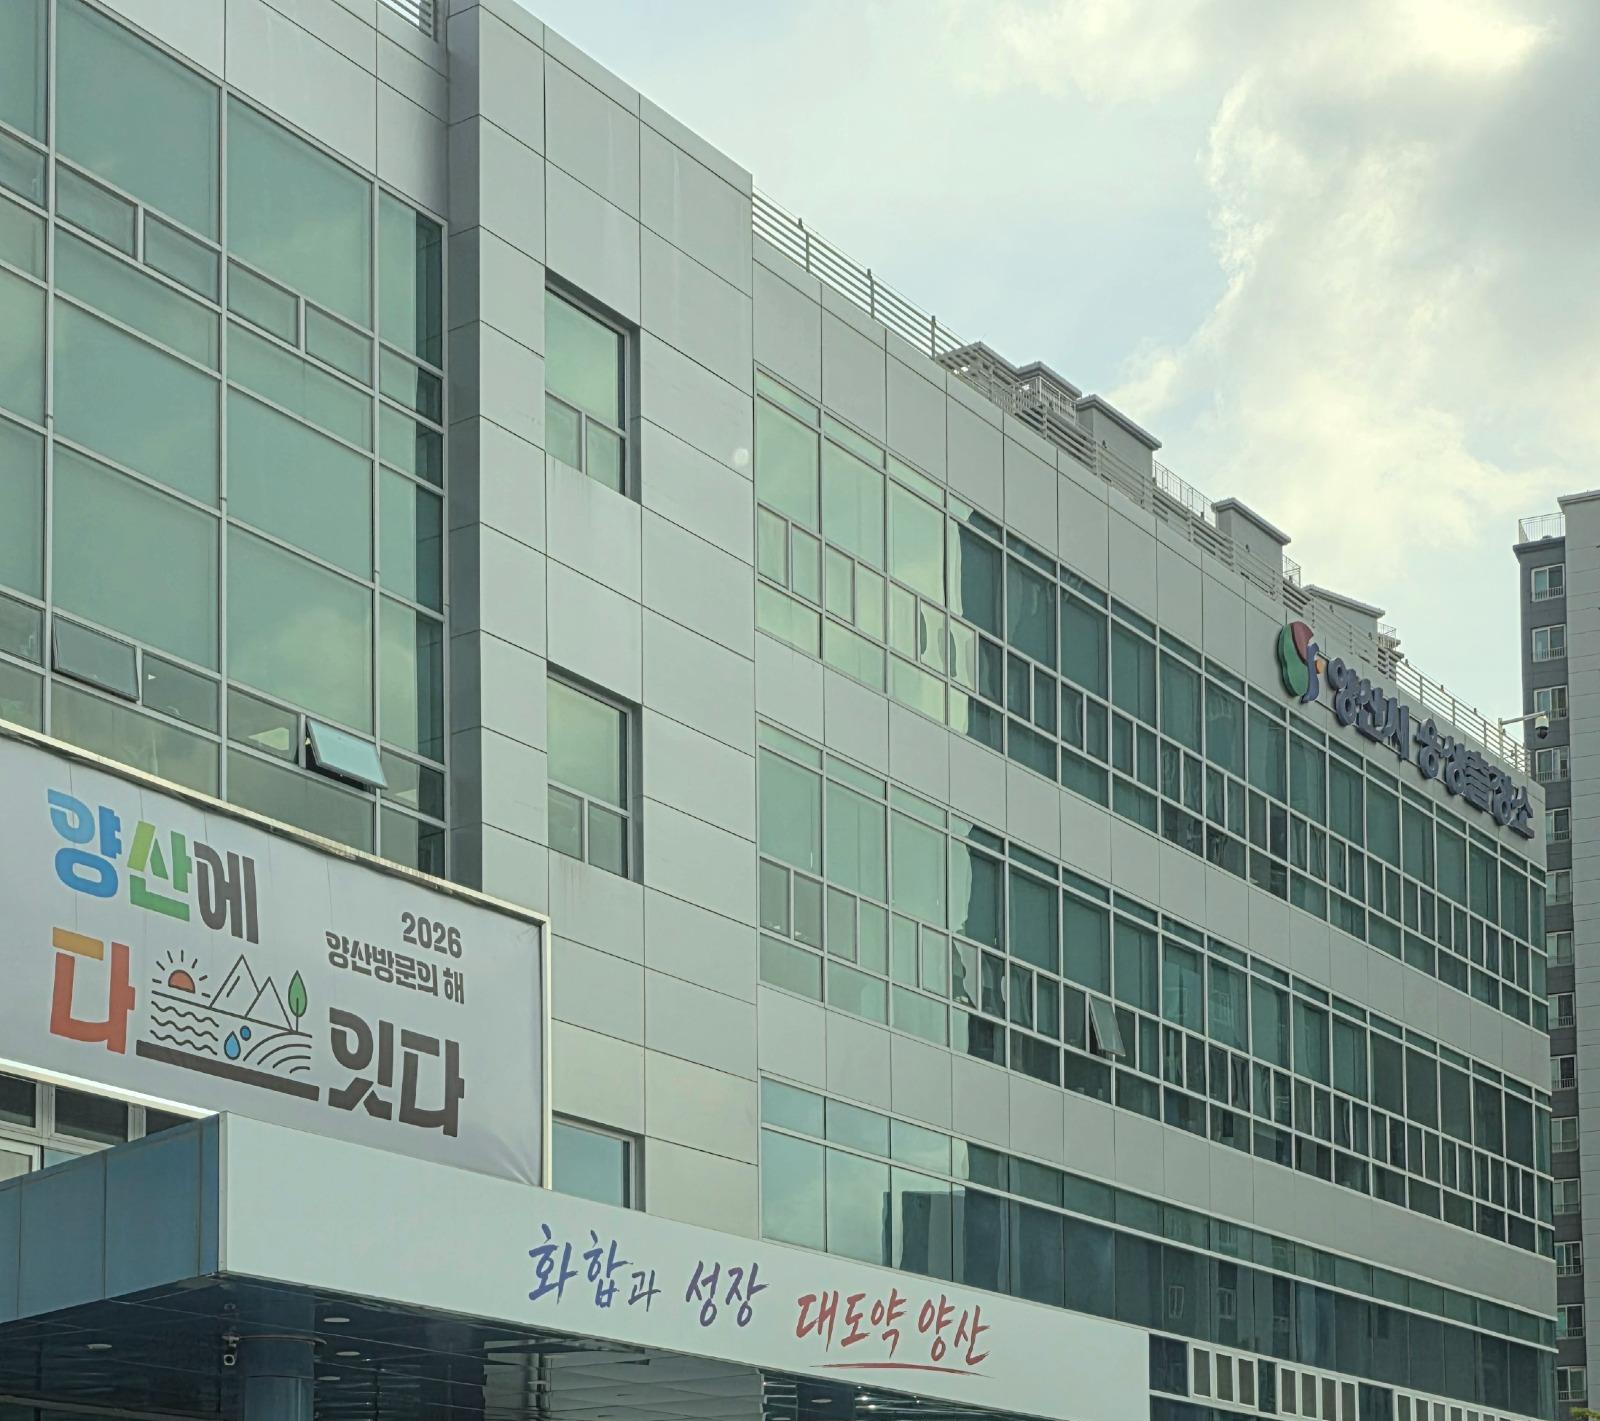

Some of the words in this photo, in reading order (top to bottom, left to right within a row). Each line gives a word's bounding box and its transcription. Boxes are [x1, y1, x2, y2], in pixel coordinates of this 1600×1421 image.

[1328, 657, 1410, 761] 양산시
[1416, 718, 1535, 840] 웅상출장소
[47, 788, 259, 944] 양산에
[401, 911, 463, 959] 2026
[49, 927, 136, 1055] 다
[328, 1007, 465, 1137] 잇다
[325, 930, 439, 997] 양산방문의
[443, 966, 465, 1005] 해
[528, 1223, 661, 1312] 화합과
[685, 1260, 769, 1327] 성장
[795, 1287, 908, 1359] 대도약
[917, 1293, 991, 1366] 양산
